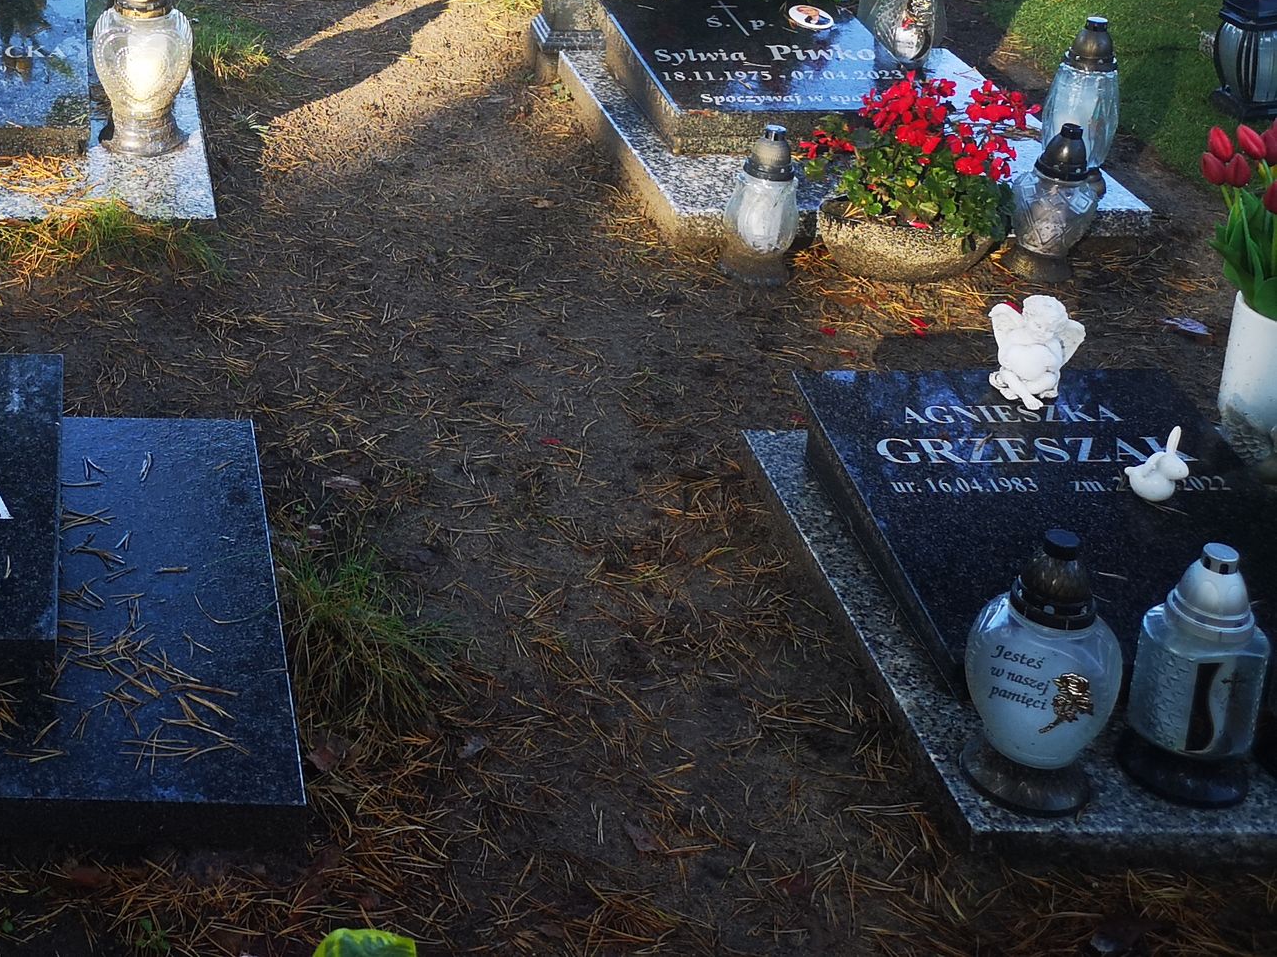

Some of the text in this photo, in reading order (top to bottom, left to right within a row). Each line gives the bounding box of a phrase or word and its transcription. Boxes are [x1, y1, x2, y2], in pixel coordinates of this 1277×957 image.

[654, 45, 876, 66] Sylwia Piwko
[663, 71, 772, 82] 18.11.1975
[791, 70, 905, 81] 07.04.2023
[700, 93, 802, 106] Spoczywaj
[904, 405, 1123, 424] AGNIESZKA
[890, 480, 922, 494] ur.
[927, 477, 1039, 493] 16.04.1983
[1074, 480, 1112, 493] zm.
[990, 644, 1045, 670] Jesteś
[989, 666, 1051, 696] w naszej
[988, 685, 1048, 711] pamięci
